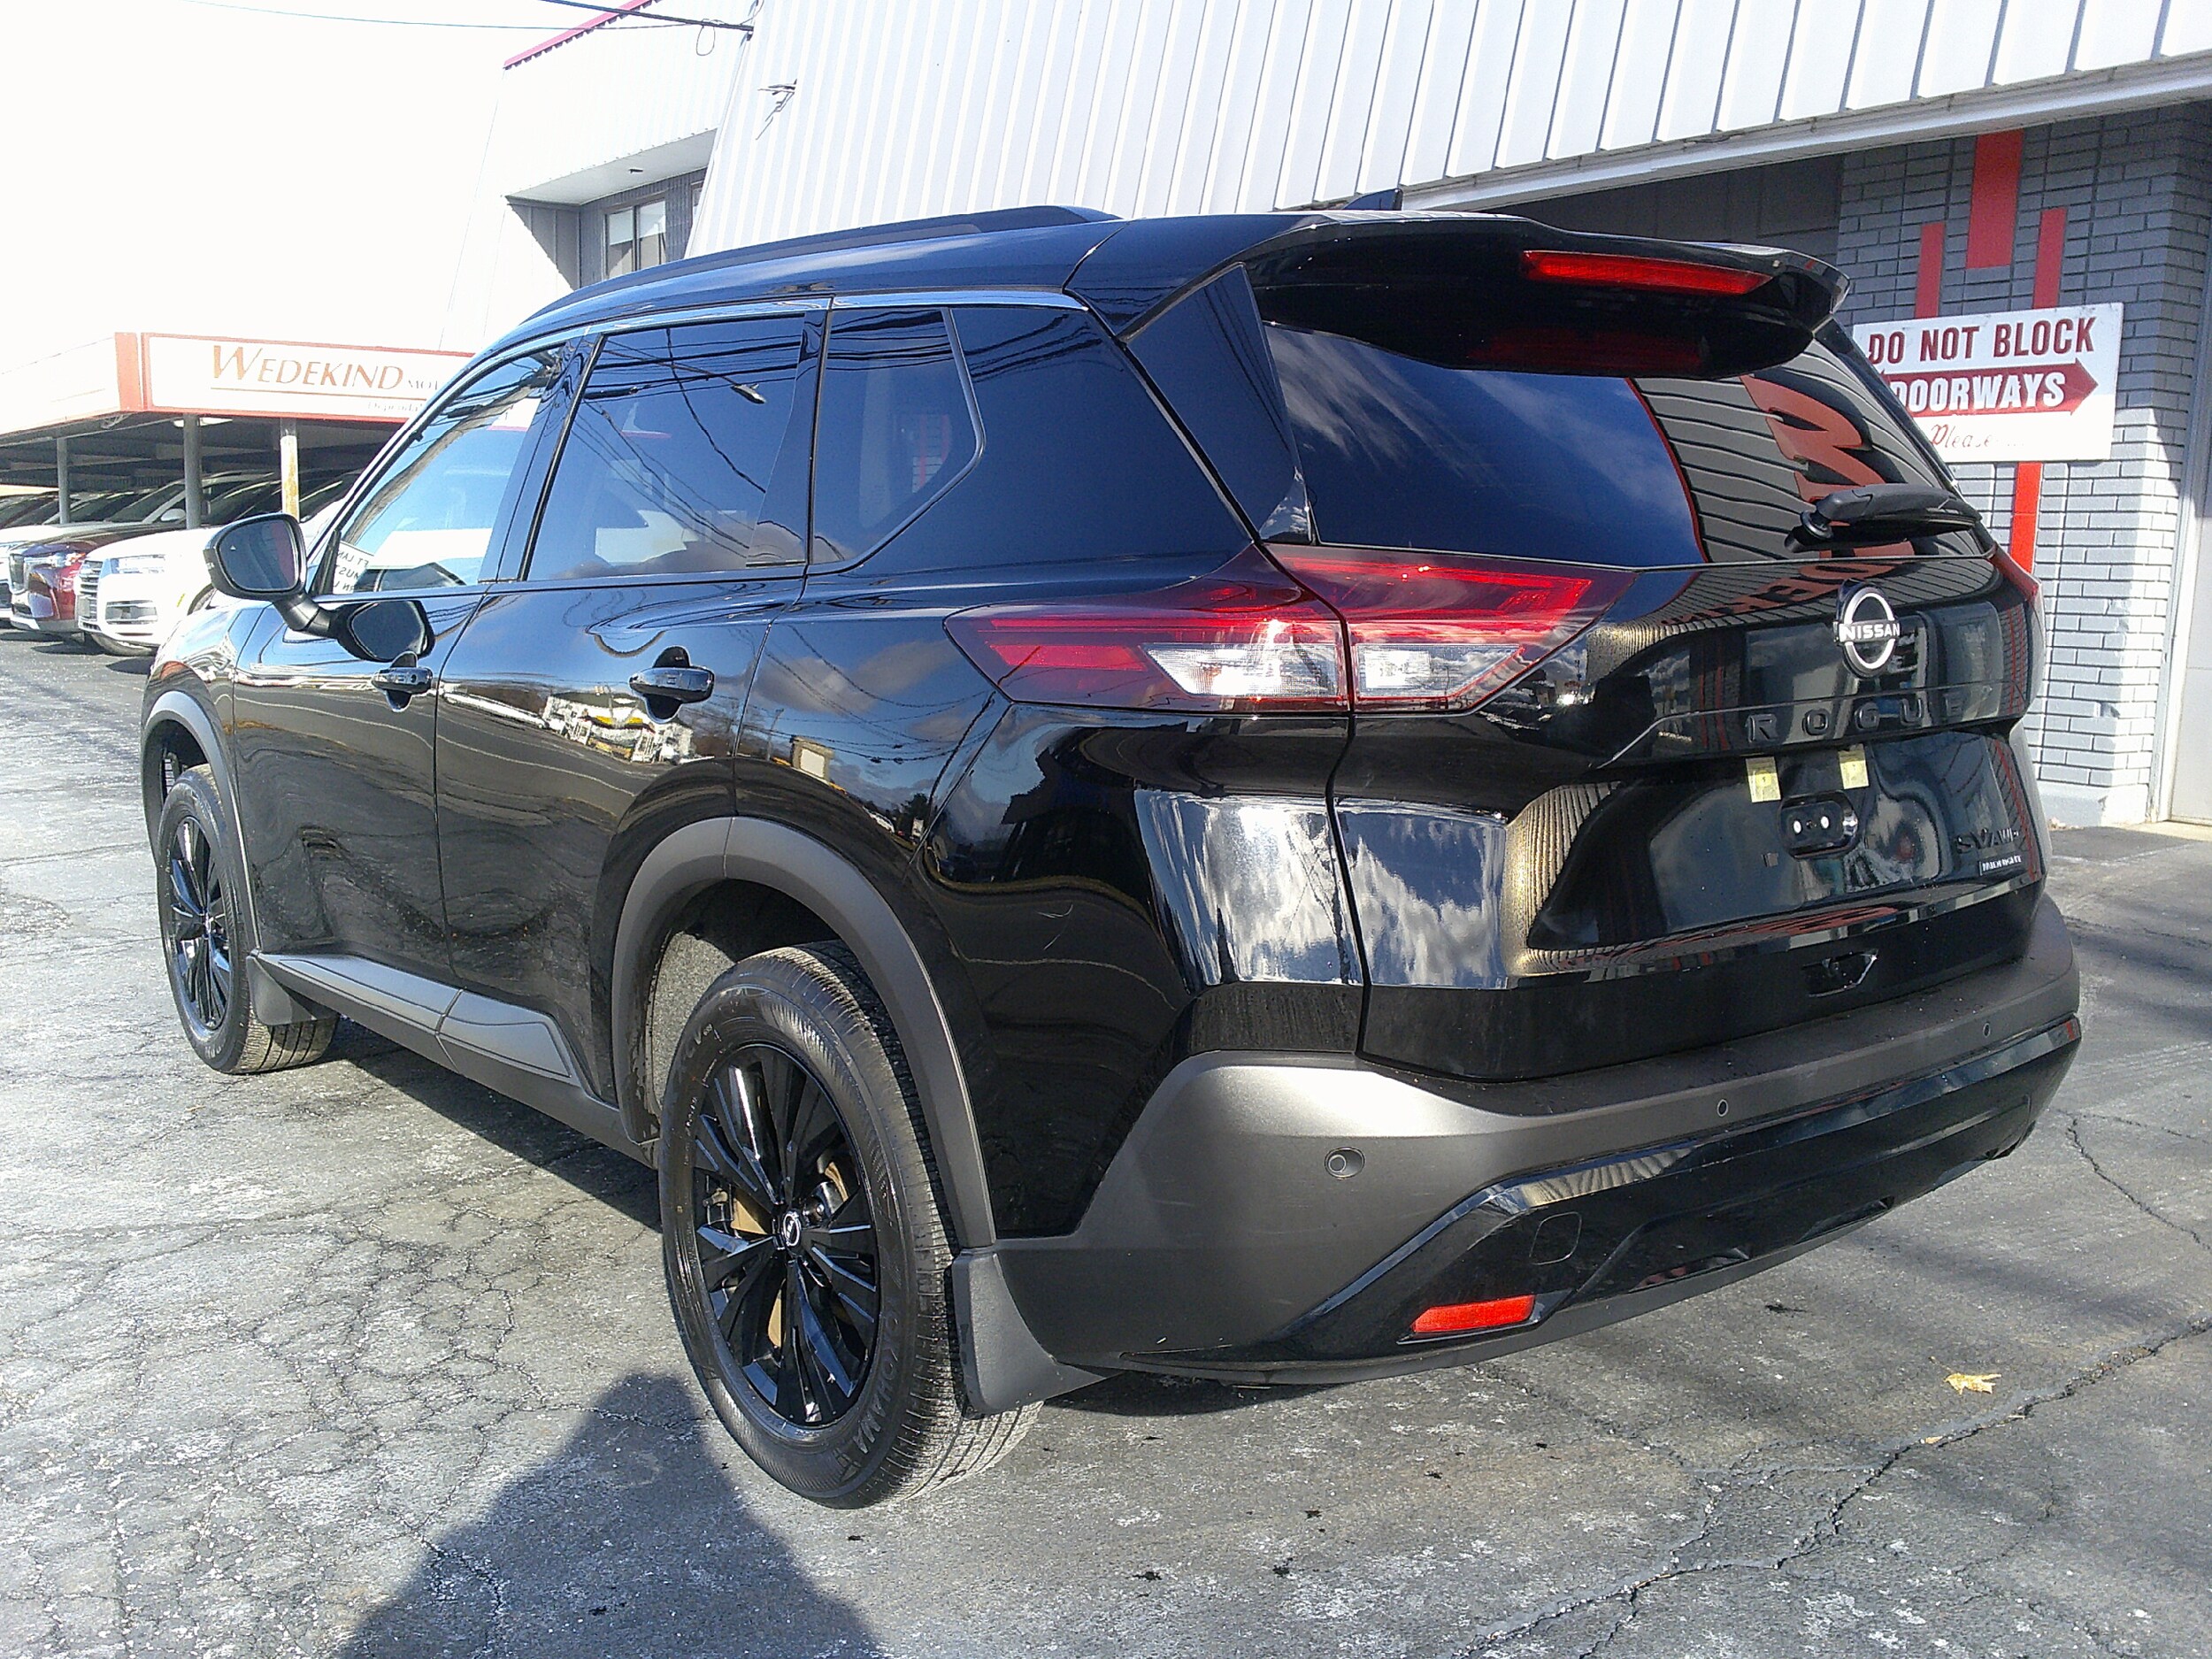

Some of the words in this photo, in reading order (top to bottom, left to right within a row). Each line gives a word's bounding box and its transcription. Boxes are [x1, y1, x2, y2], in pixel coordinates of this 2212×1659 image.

[1868, 331, 1904, 365] DO
[1920, 326, 1979, 362] NOT
[1993, 317, 2096, 357] BLOCK
[213, 345, 403, 389] WEDEKIND
[1839, 622, 1900, 642] NISSAN
[1747, 693, 1963, 743] ROGUE
